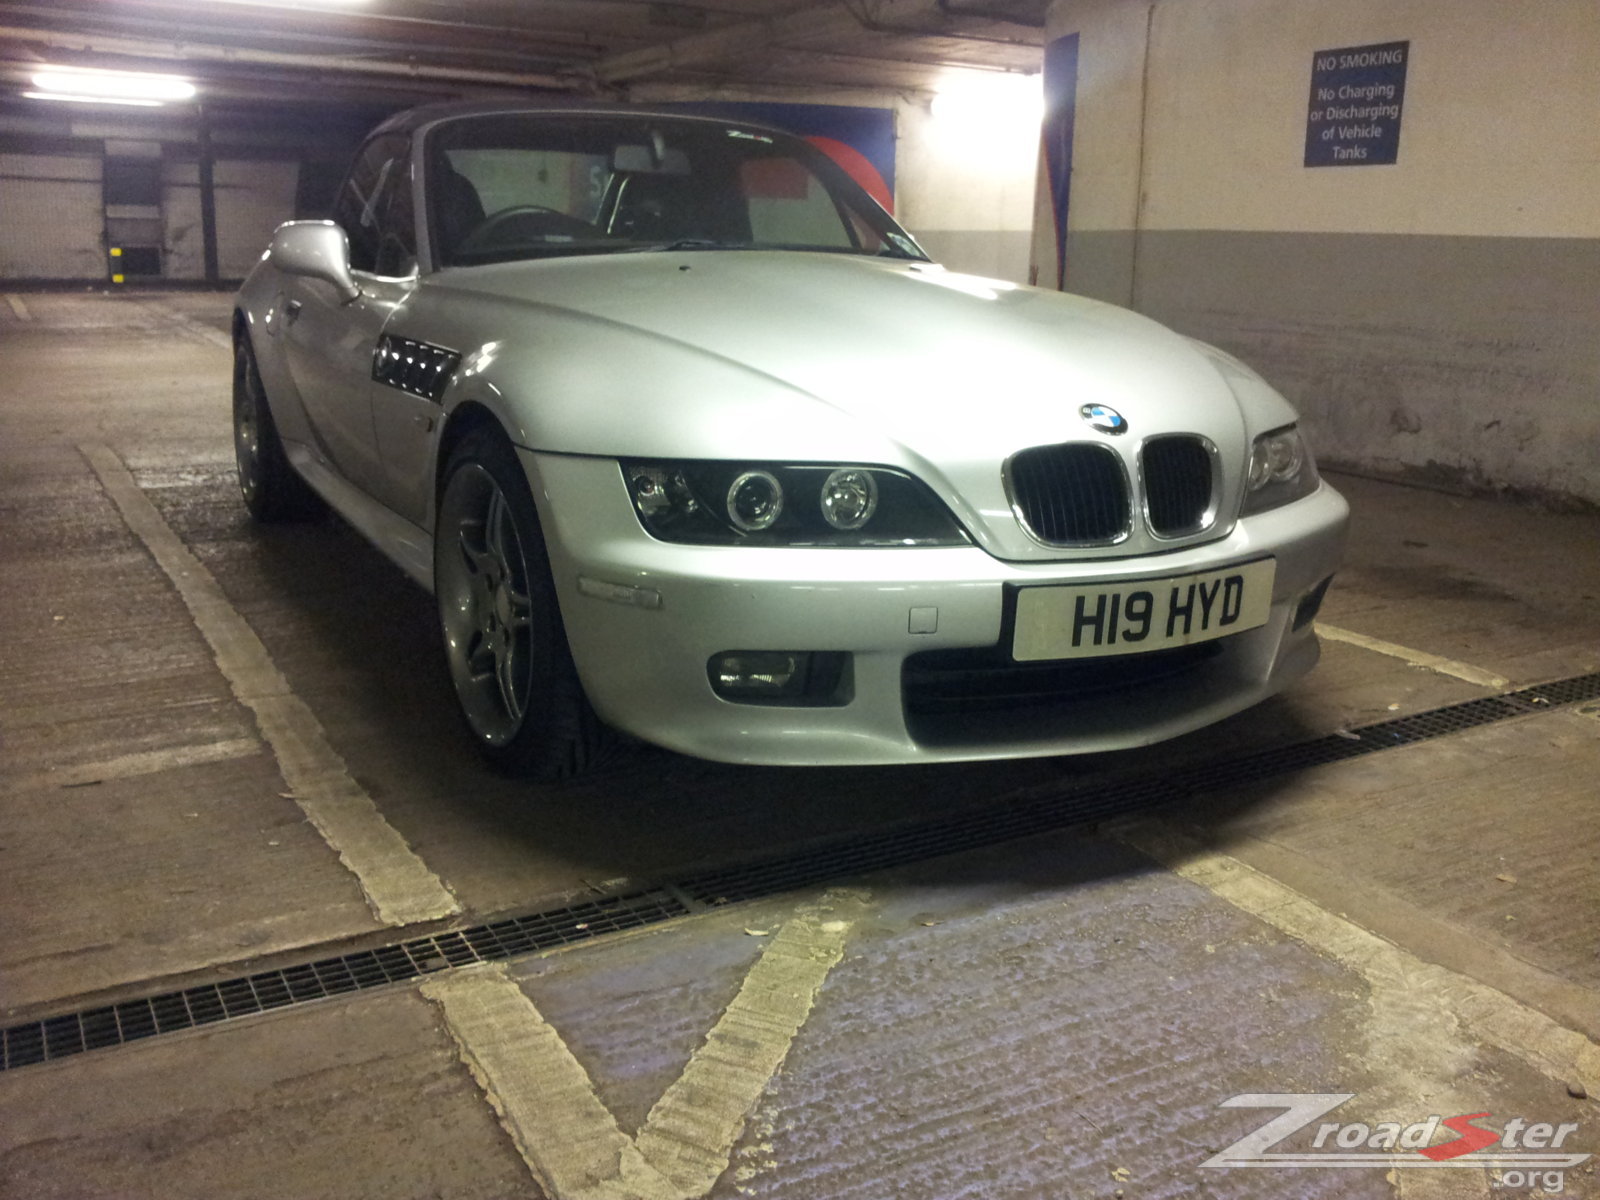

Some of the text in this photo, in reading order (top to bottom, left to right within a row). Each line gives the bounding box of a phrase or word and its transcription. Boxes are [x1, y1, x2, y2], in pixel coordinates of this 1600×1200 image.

[1317, 49, 1402, 71] NO SMOKING
[1318, 82, 1395, 101] No Charging
[1310, 102, 1399, 121] or Discharging
[1321, 124, 1382, 141] of Vehicle
[1333, 145, 1367, 159] Tanks
[1072, 574, 1245, 647] H19 HYD
